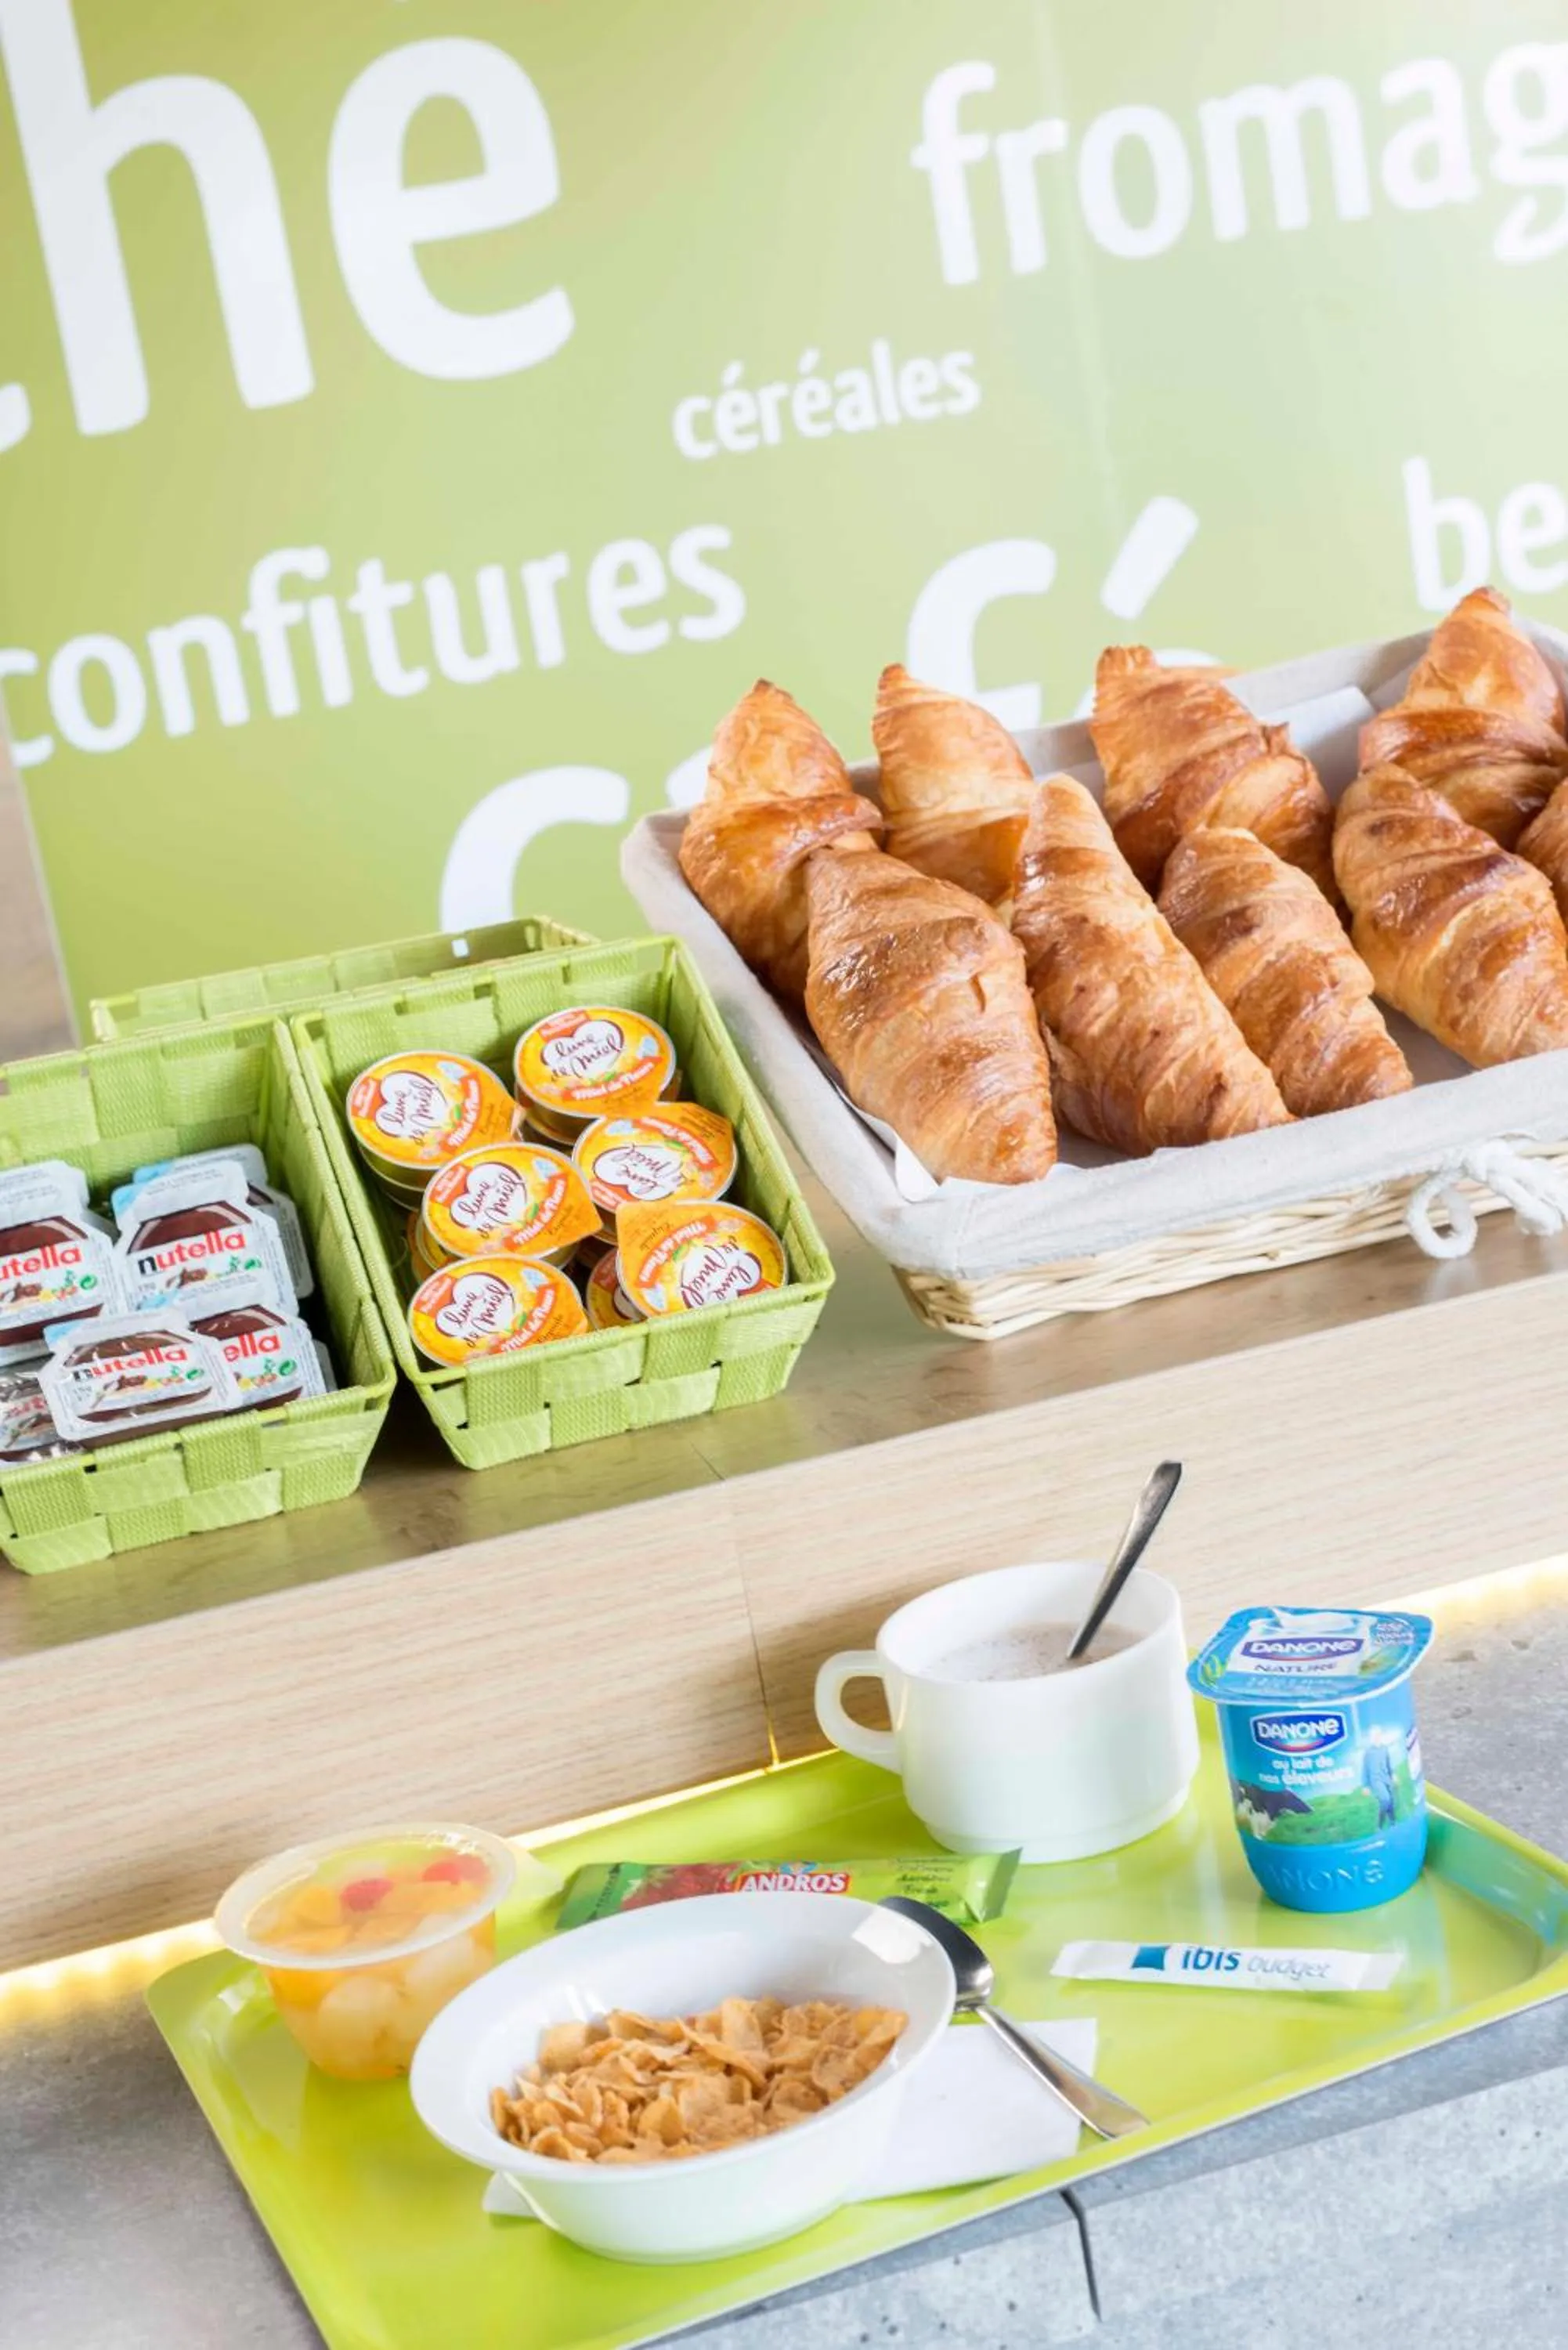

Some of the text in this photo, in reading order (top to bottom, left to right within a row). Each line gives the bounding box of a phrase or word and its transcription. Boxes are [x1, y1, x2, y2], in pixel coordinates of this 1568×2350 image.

[0, 0, 576, 453] he
[672, 338, 981, 461] céréales
[137, 1230, 247, 1275] nutella
[222, 1330, 282, 1363] ella
[71, 1347, 188, 1381] nutella
[1250, 1640, 1357, 1654] DANONE
[1257, 1718, 1340, 1739] DANONE
[742, 1873, 847, 1893] ANDROS
[1181, 1945, 1331, 1980] ibis budget
